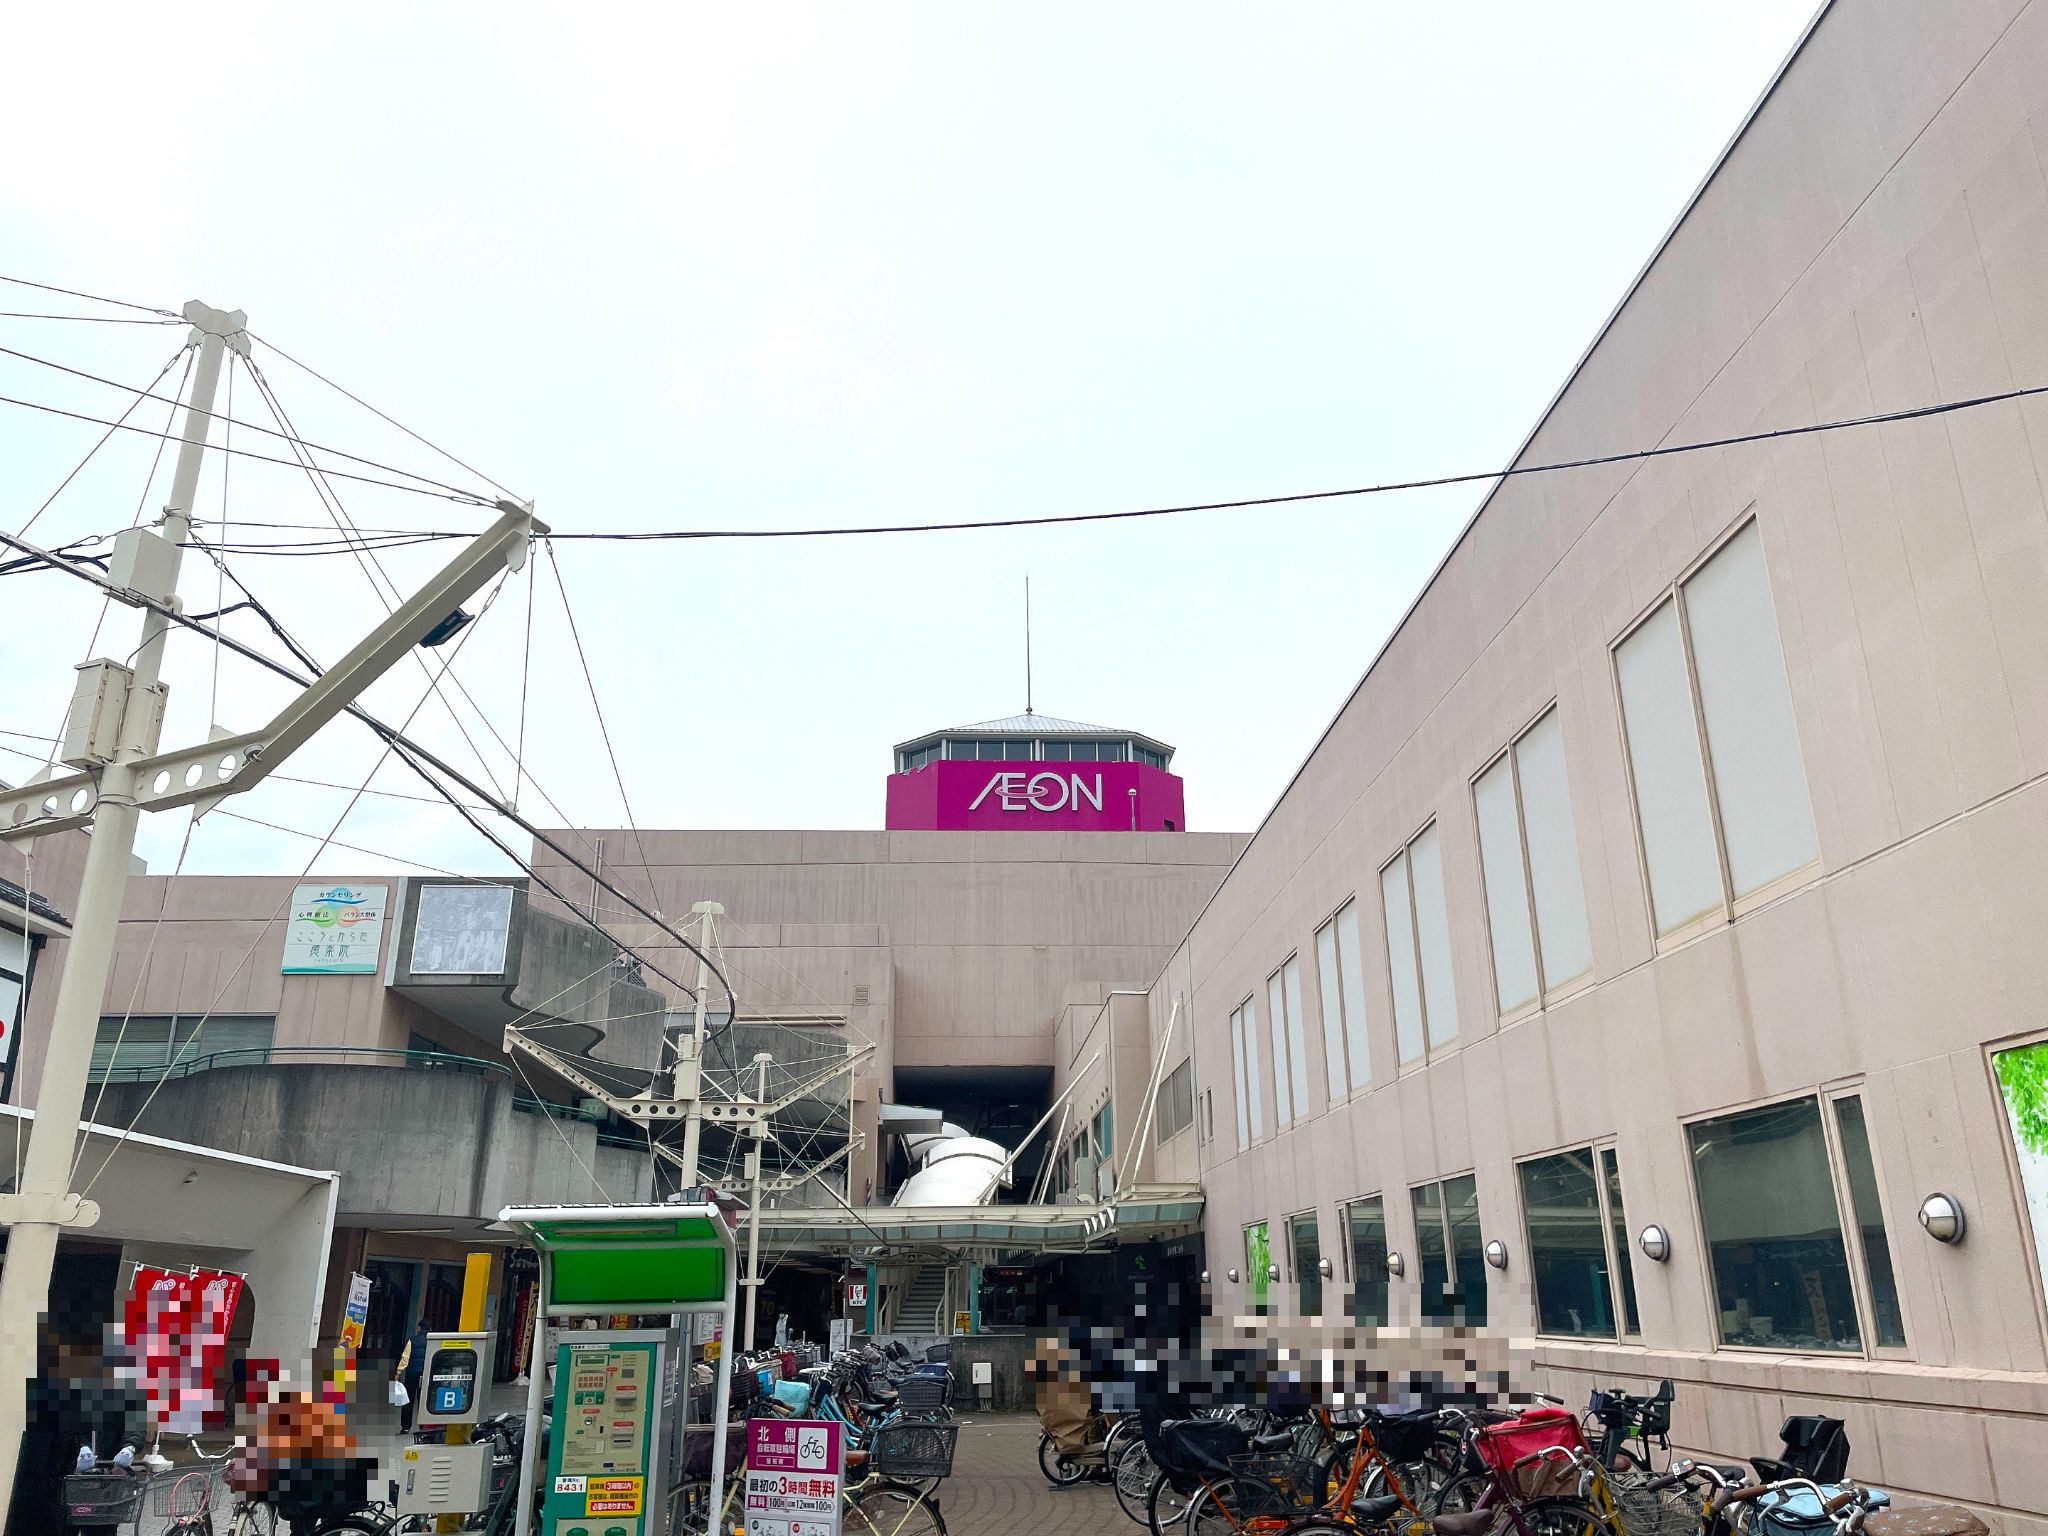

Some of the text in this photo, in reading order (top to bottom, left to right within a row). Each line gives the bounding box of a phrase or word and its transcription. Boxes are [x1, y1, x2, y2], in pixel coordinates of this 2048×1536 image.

[296, 931, 368, 942] こころとからだ
[443, 1391, 456, 1408] B
[556, 1483, 583, 1492] 8431
[750, 1476, 836, 1498] 最初の3時間無料
